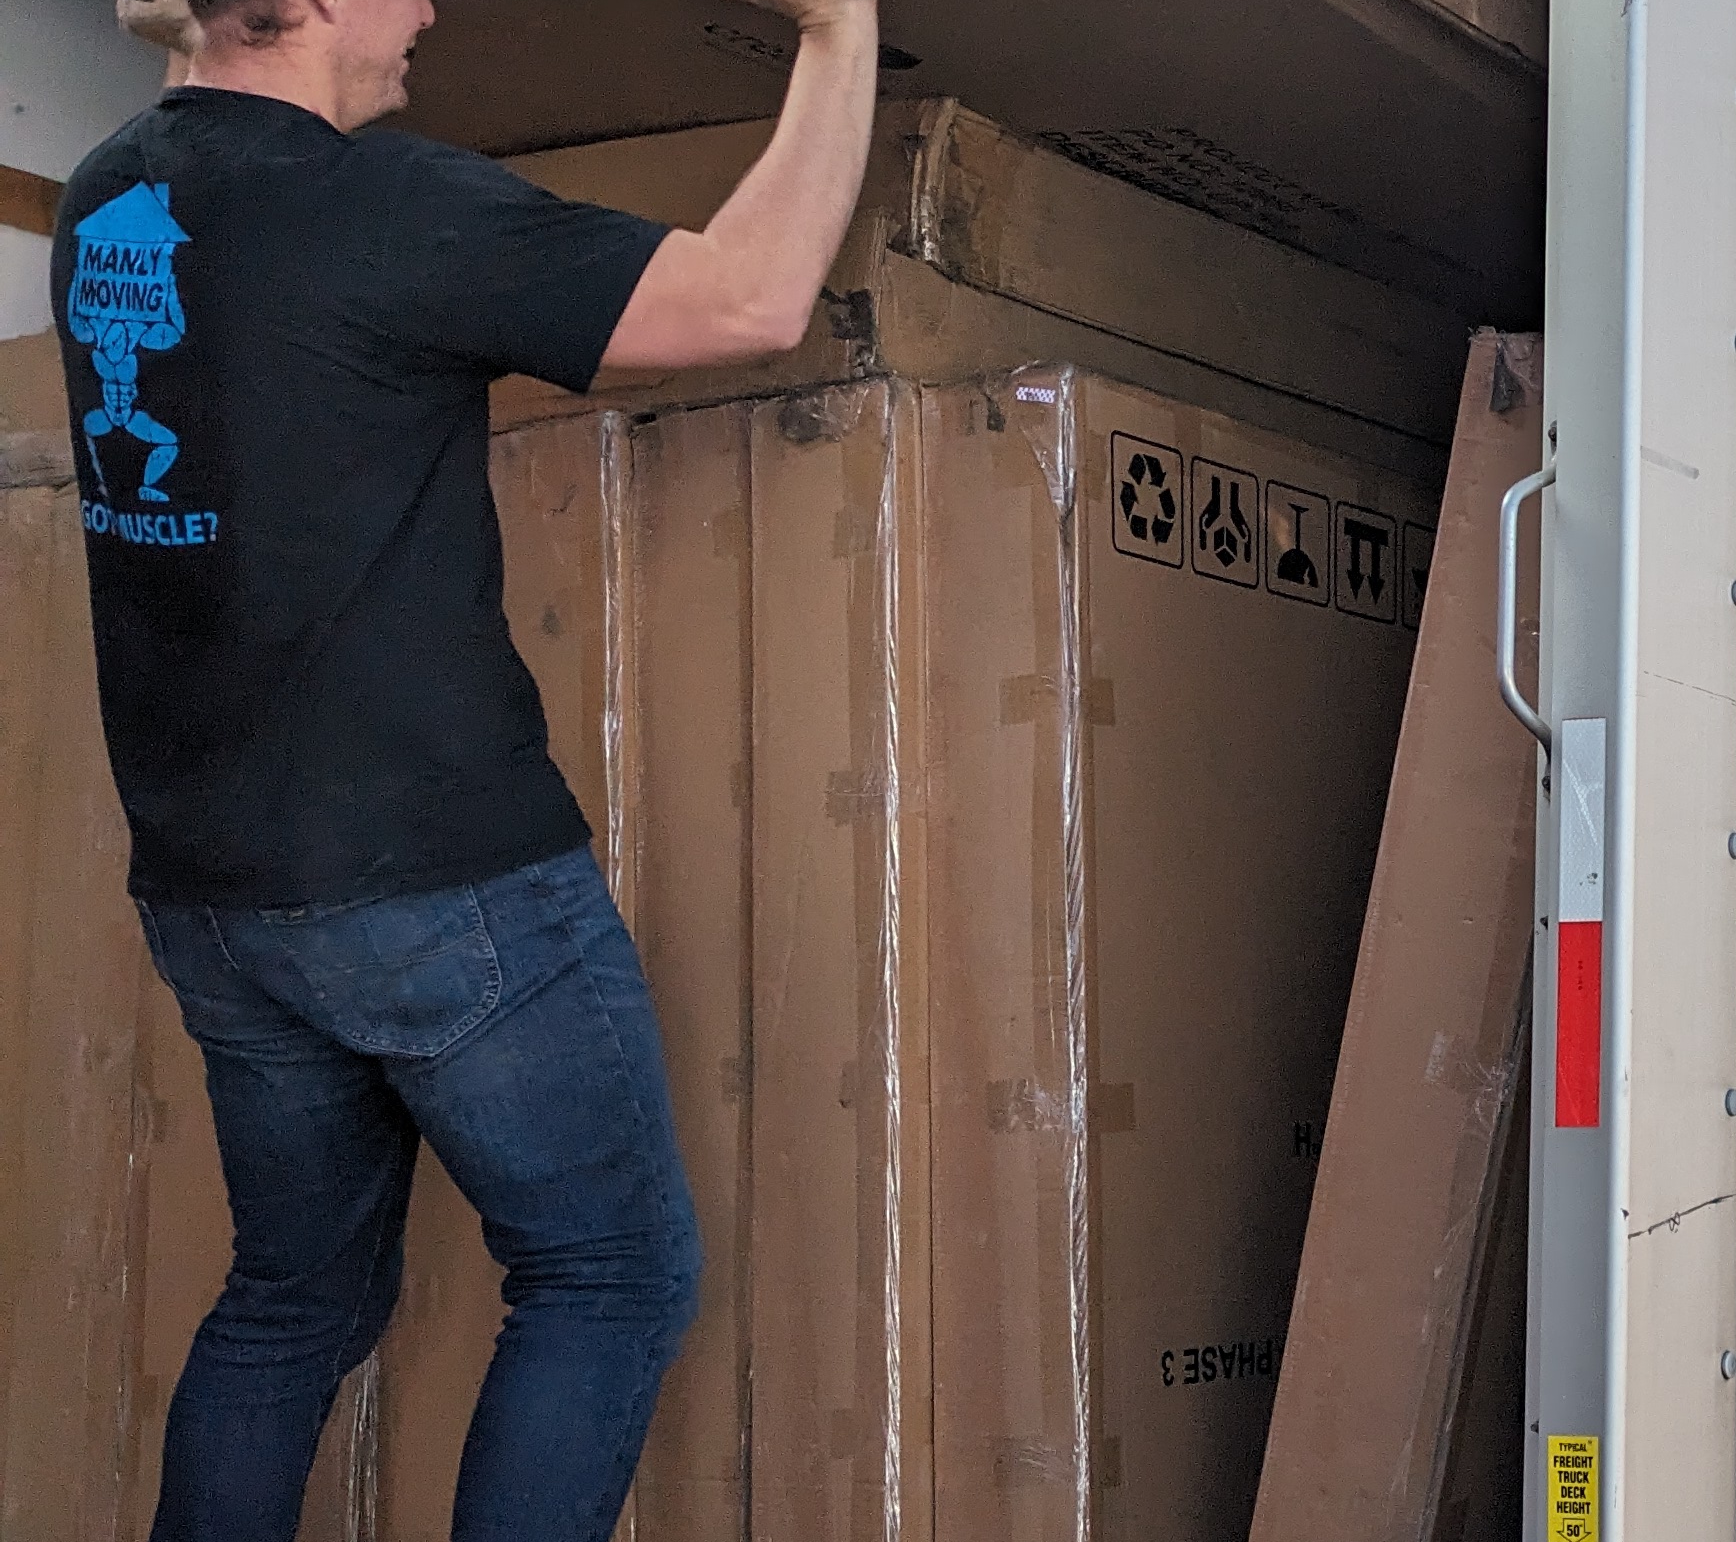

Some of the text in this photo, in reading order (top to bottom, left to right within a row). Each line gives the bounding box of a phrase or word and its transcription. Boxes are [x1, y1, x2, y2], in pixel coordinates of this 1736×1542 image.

[83, 243, 162, 272] MANLY
[78, 279, 164, 312] MOVING
[1161, 1339, 1272, 1386] PHASE 3
[1559, 1443, 1587, 1452] TYPICAL
[1554, 1456, 1593, 1468] FREIGHT
[1558, 1471, 1589, 1484] TRUCK
[1561, 1486, 1586, 1498] DECK
[1557, 1502, 1591, 1514] HEIGHT
